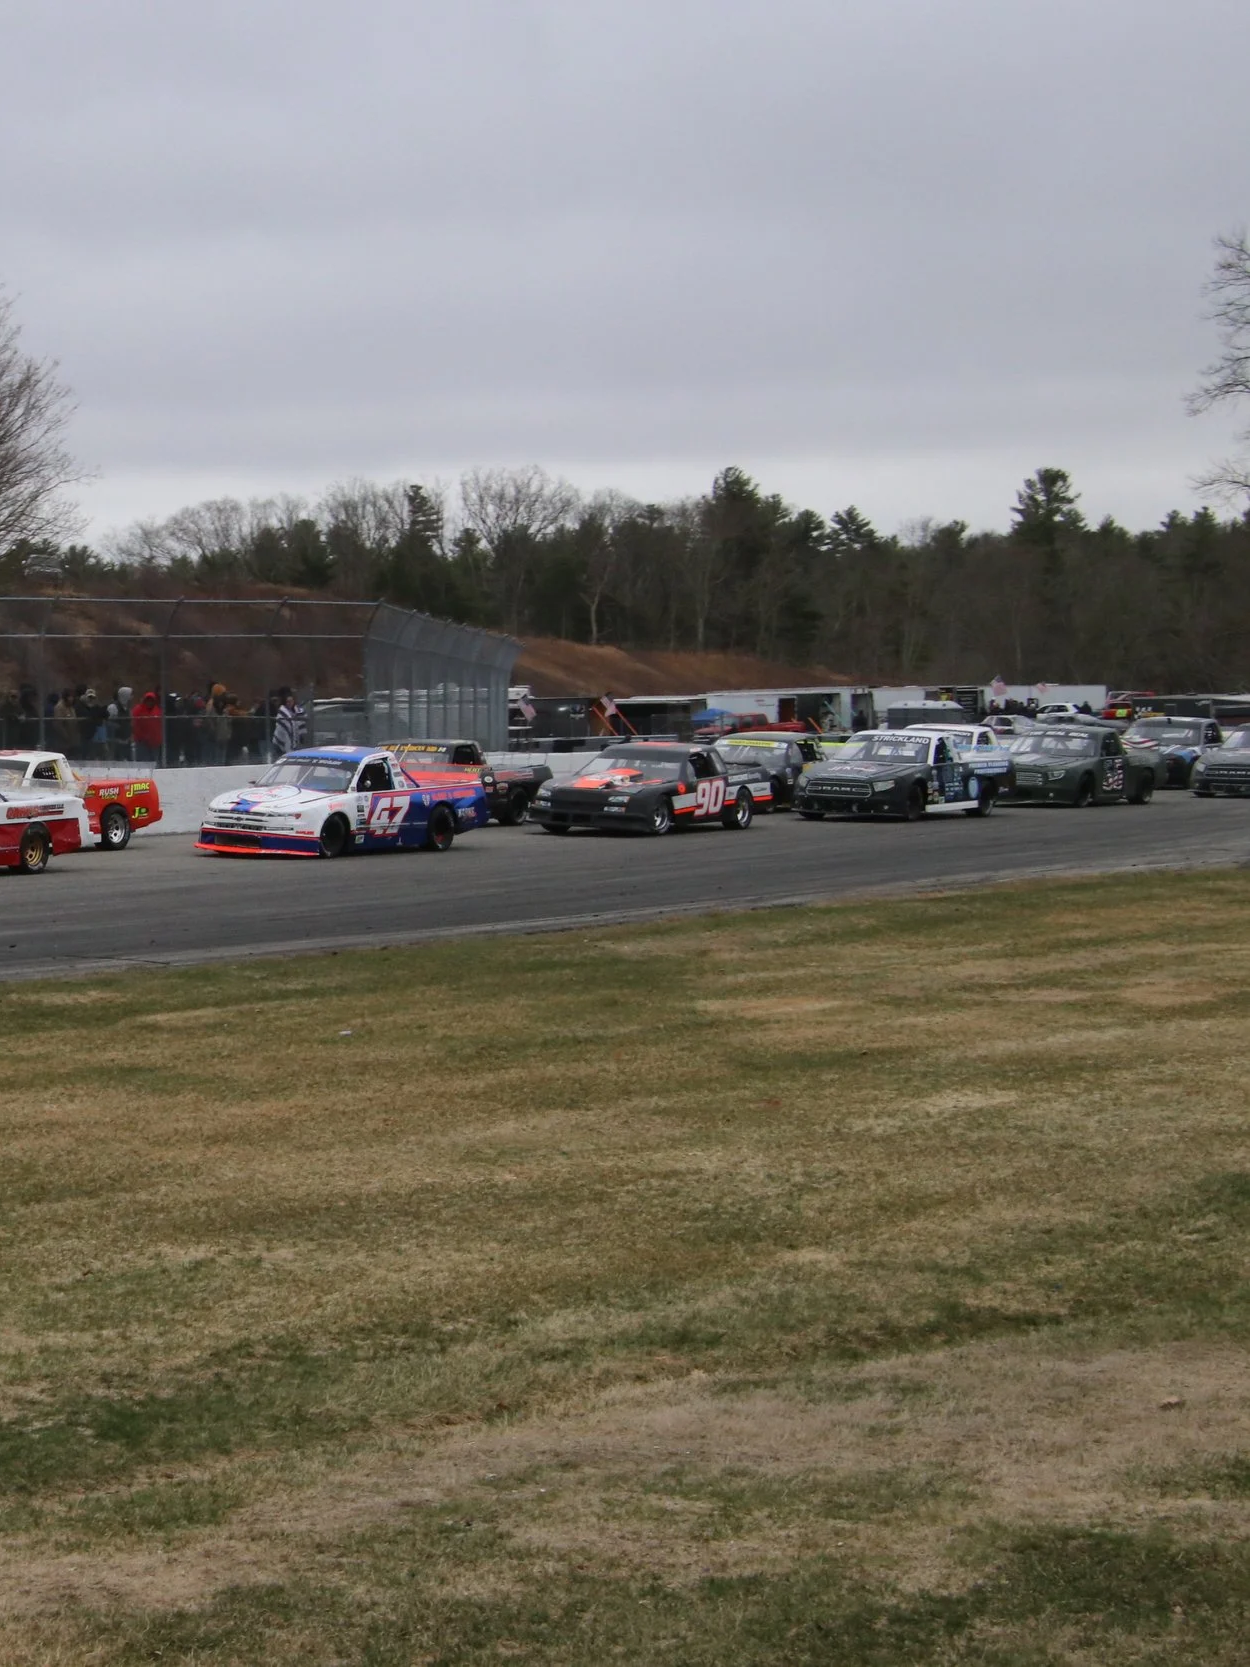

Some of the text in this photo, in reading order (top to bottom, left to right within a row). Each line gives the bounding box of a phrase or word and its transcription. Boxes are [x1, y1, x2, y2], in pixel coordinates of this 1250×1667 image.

[872, 735, 930, 745] STRICKLAND
[99, 786, 120, 797] RUSH
[694, 779, 726, 816] 90
